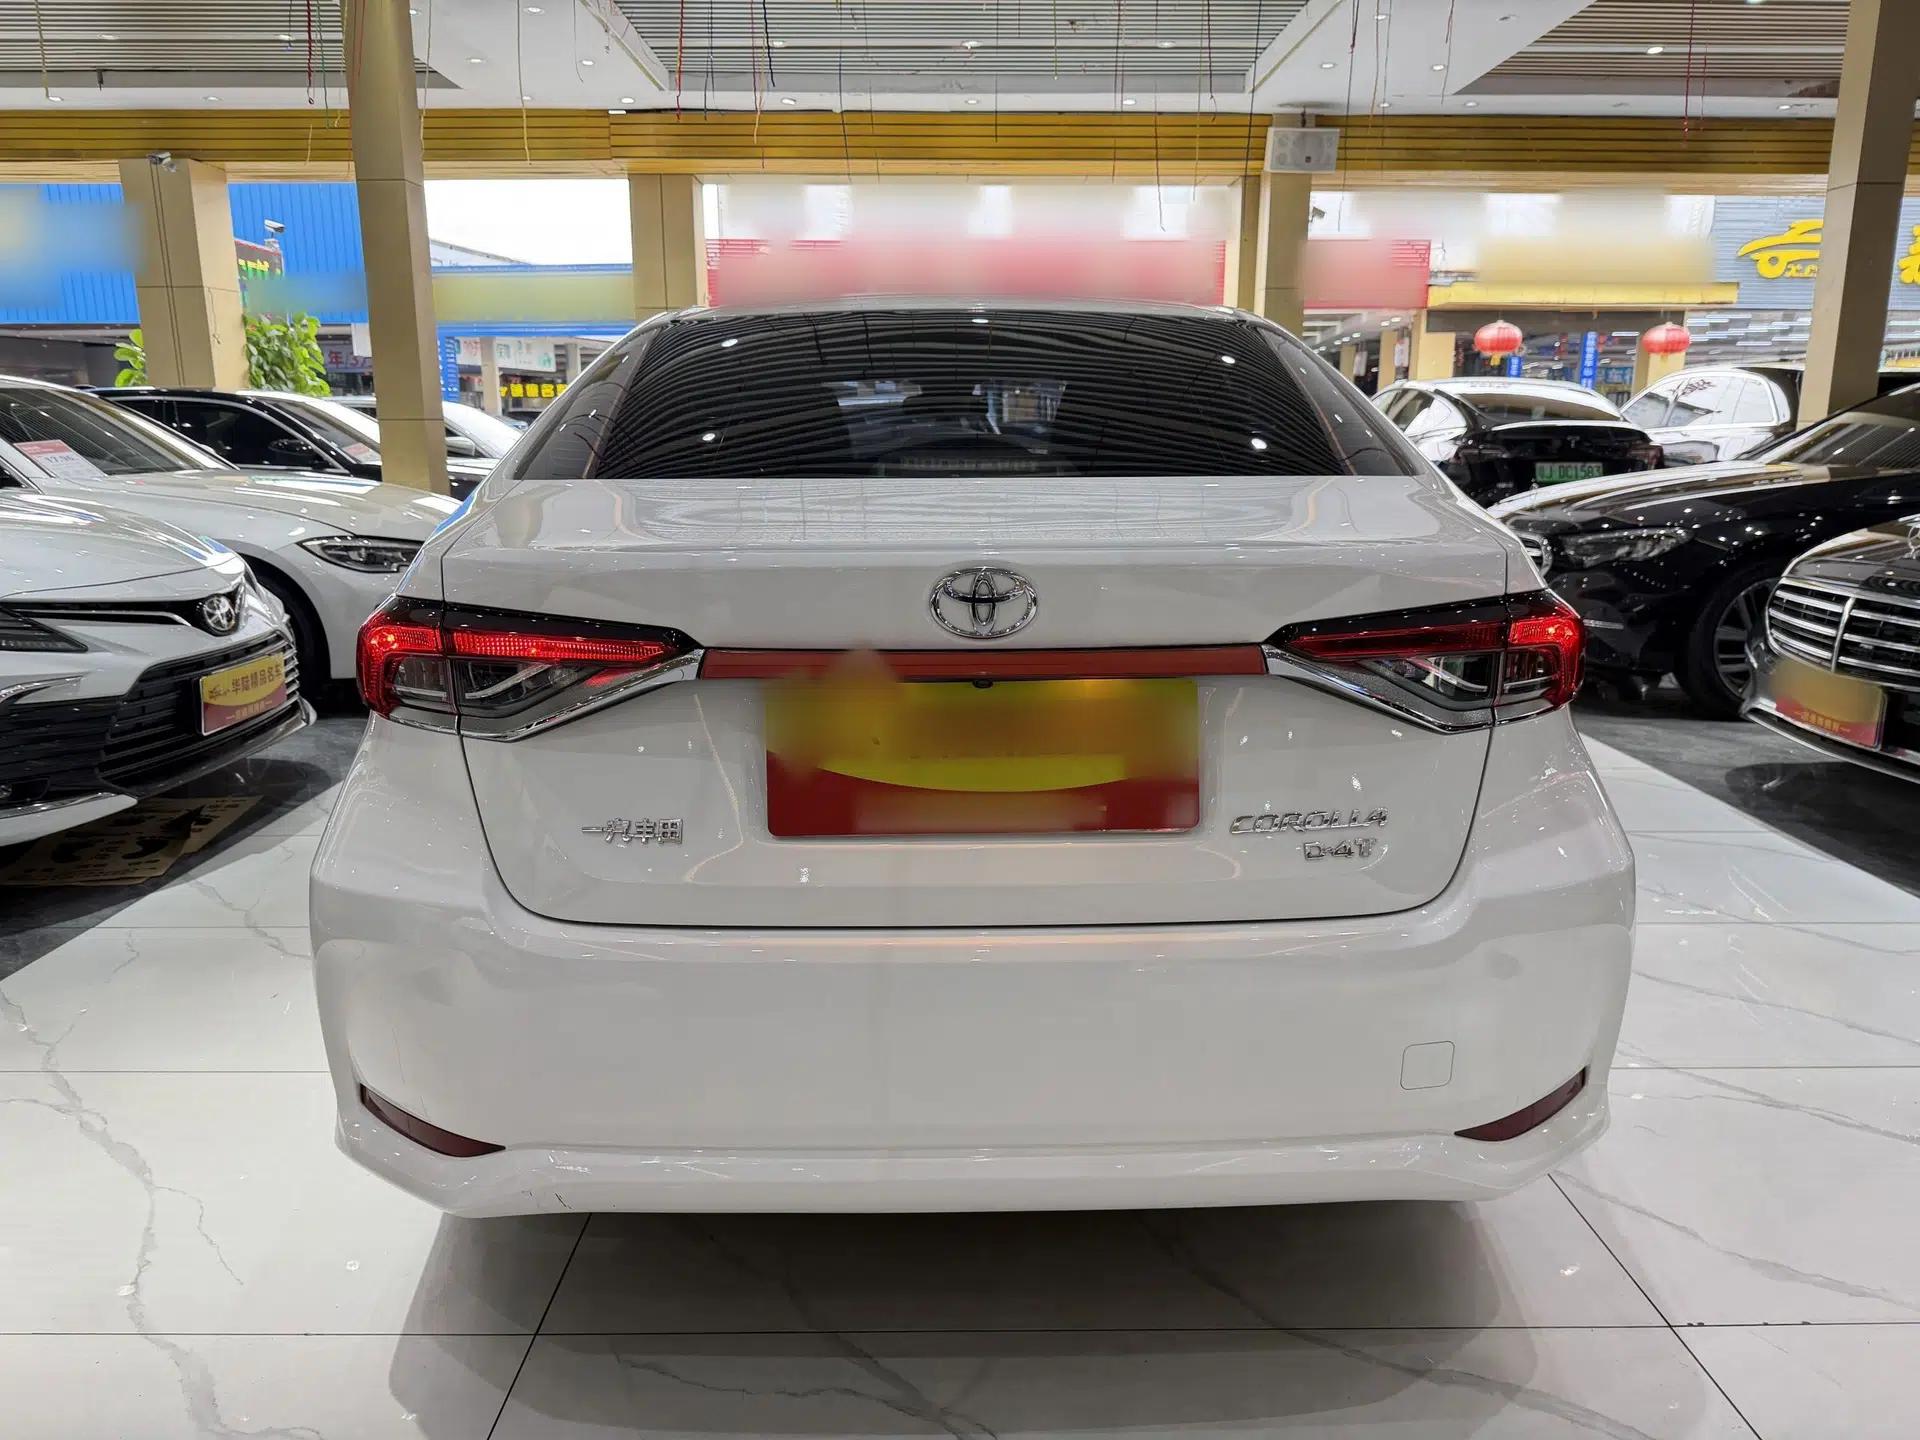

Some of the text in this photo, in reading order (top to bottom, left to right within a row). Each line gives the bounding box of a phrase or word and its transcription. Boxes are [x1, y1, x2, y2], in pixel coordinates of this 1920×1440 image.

[581, 818, 683, 844] 一汽丰田
[1229, 807, 1389, 834] COROLLA
